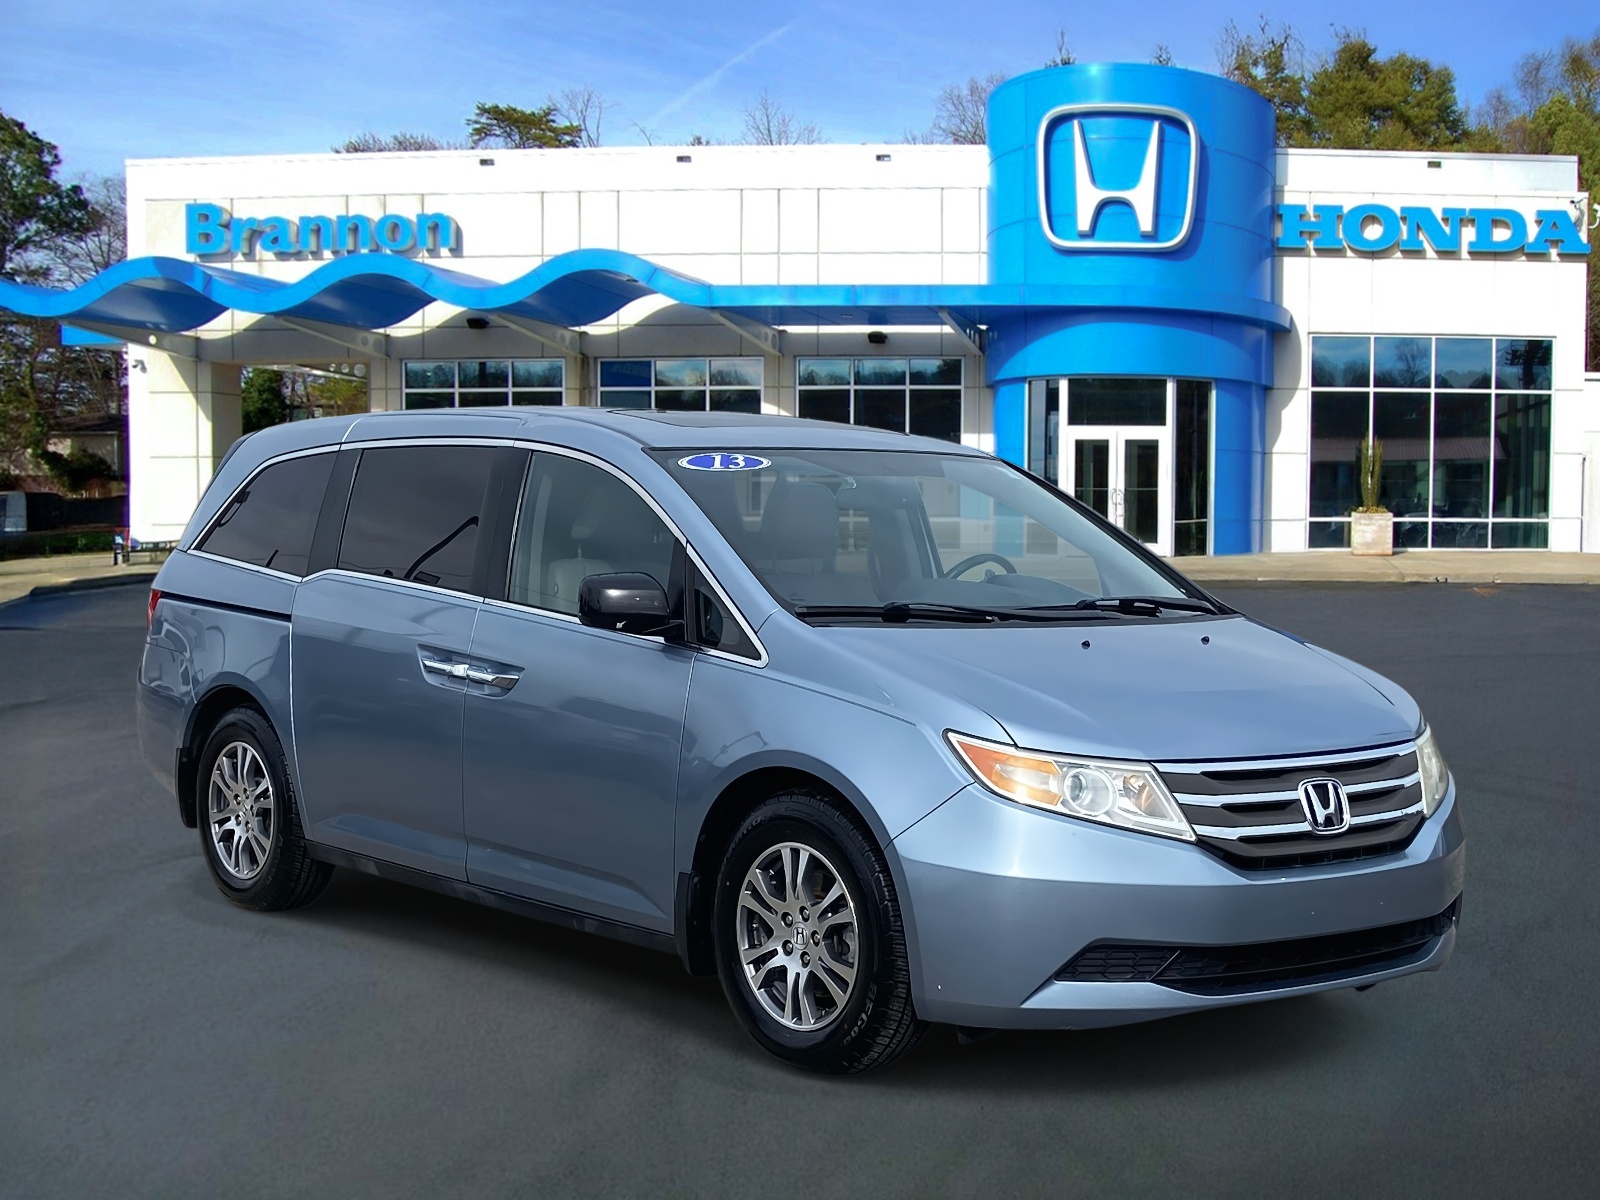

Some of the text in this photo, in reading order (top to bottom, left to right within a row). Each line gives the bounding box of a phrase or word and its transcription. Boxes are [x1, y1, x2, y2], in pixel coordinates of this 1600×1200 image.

[185, 203, 455, 256] Brannon
[1277, 203, 1592, 254] HONDA
[710, 454, 746, 469] 13
